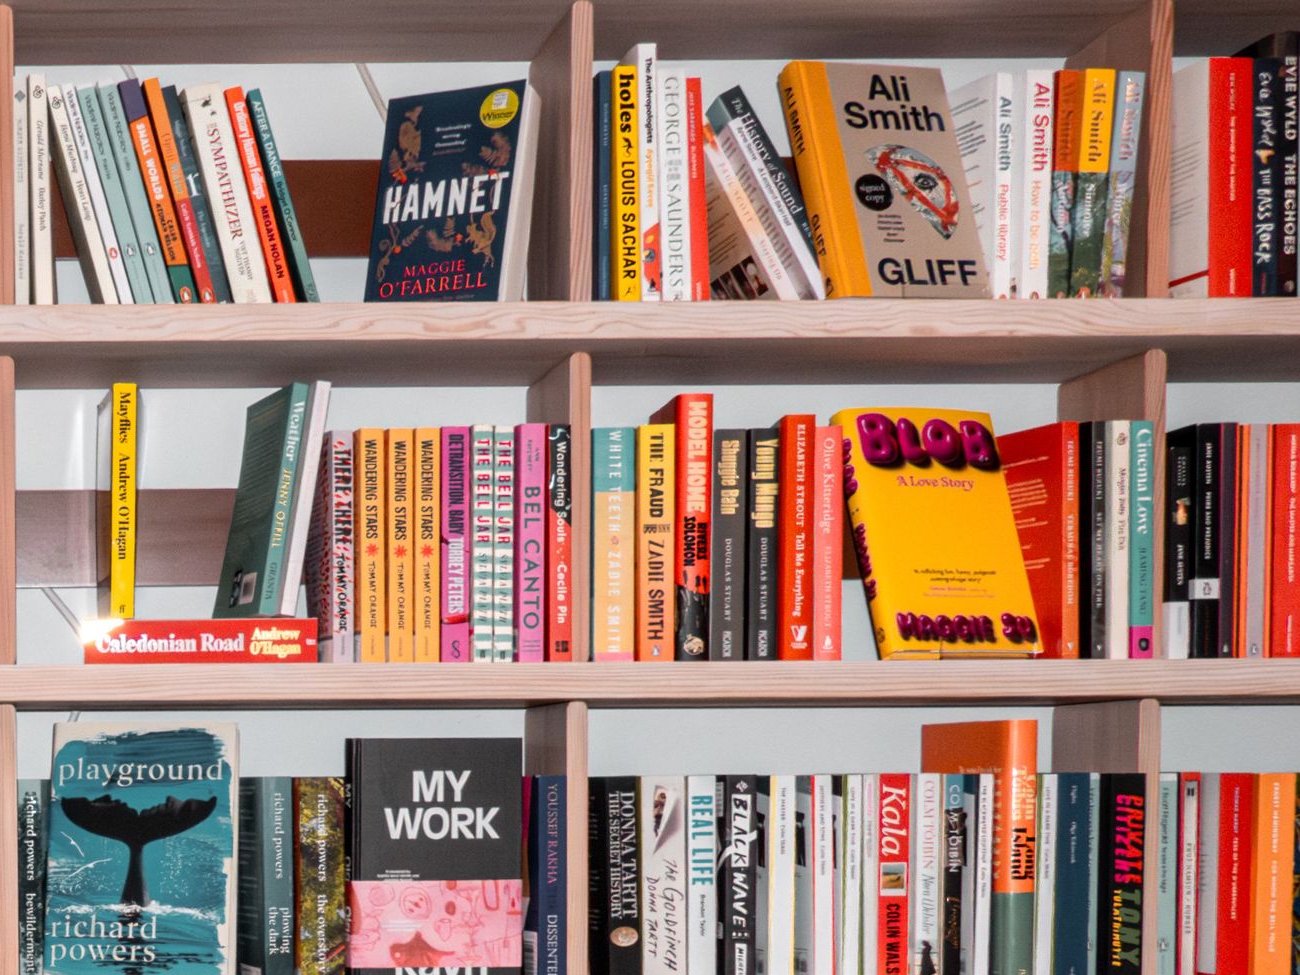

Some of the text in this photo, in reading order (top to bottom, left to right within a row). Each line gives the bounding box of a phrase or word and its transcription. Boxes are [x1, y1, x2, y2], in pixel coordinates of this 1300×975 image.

[868, 74, 911, 102] Ali
[482, 110, 514, 120] Winner
[844, 102, 946, 133] Smith
[1284, 56, 1297, 256] EVIE WYLD THE ECHOES
[620, 74, 636, 280] holes LOUIS SACHAR
[382, 171, 509, 224] HAMNET
[403, 260, 465, 277] MAGGIE
[878, 258, 977, 287] GLIFF
[379, 272, 487, 300] O'FARRELL
[857, 413, 1000, 470] BLOB
[117, 392, 131, 560] Mayflies Andrew O'Hagan
[1136, 428, 1151, 534] Cinema Love
[647, 433, 664, 639] THE FRAUD ZADIE SMITH
[523, 485, 542, 629] BEL CANTO
[59, 757, 224, 789] playground
[412, 770, 472, 802] MY
[383, 806, 500, 840] WORK
[608, 791, 622, 920] THE SECRET HISTORY
[620, 791, 638, 919] DONNA TARTT
[50, 916, 157, 940] richard
[50, 942, 156, 968] powers
